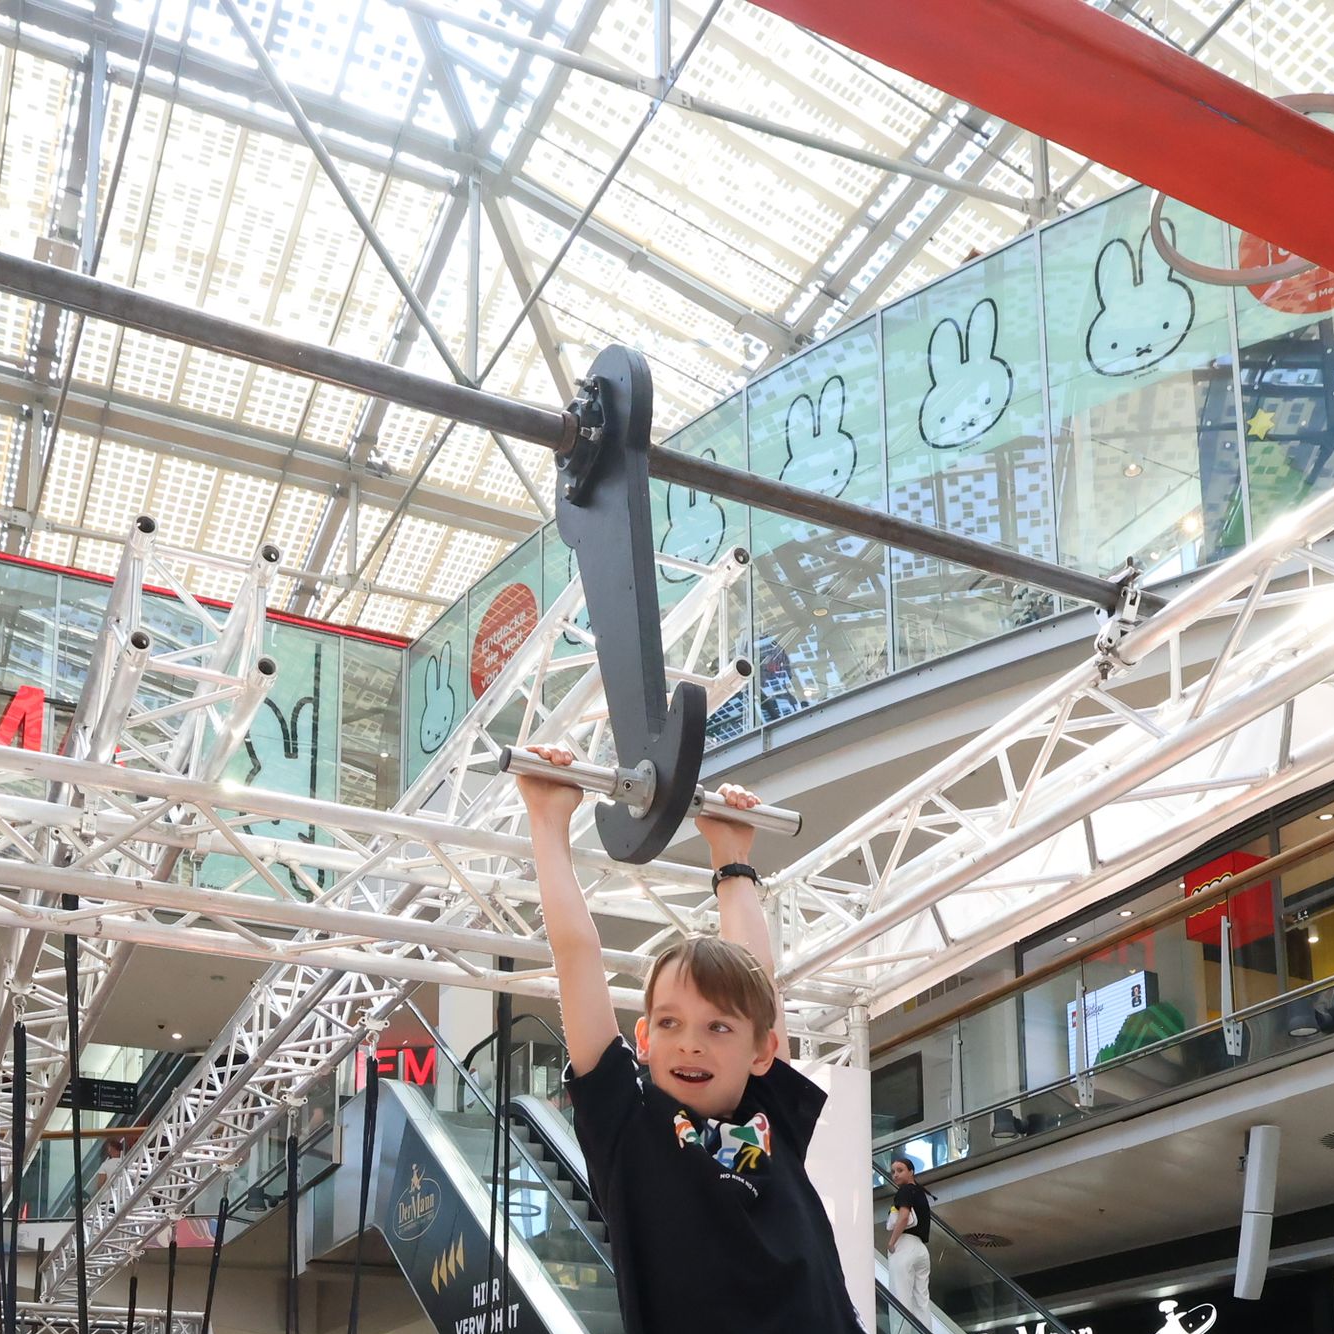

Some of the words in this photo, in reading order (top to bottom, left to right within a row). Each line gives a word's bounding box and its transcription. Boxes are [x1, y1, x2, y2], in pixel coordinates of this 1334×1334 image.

[481, 609, 527, 655] Entdecke
[484, 650, 499, 669] die
[398, 1191, 435, 1224] DerMann
[472, 1278, 500, 1308] HIR
